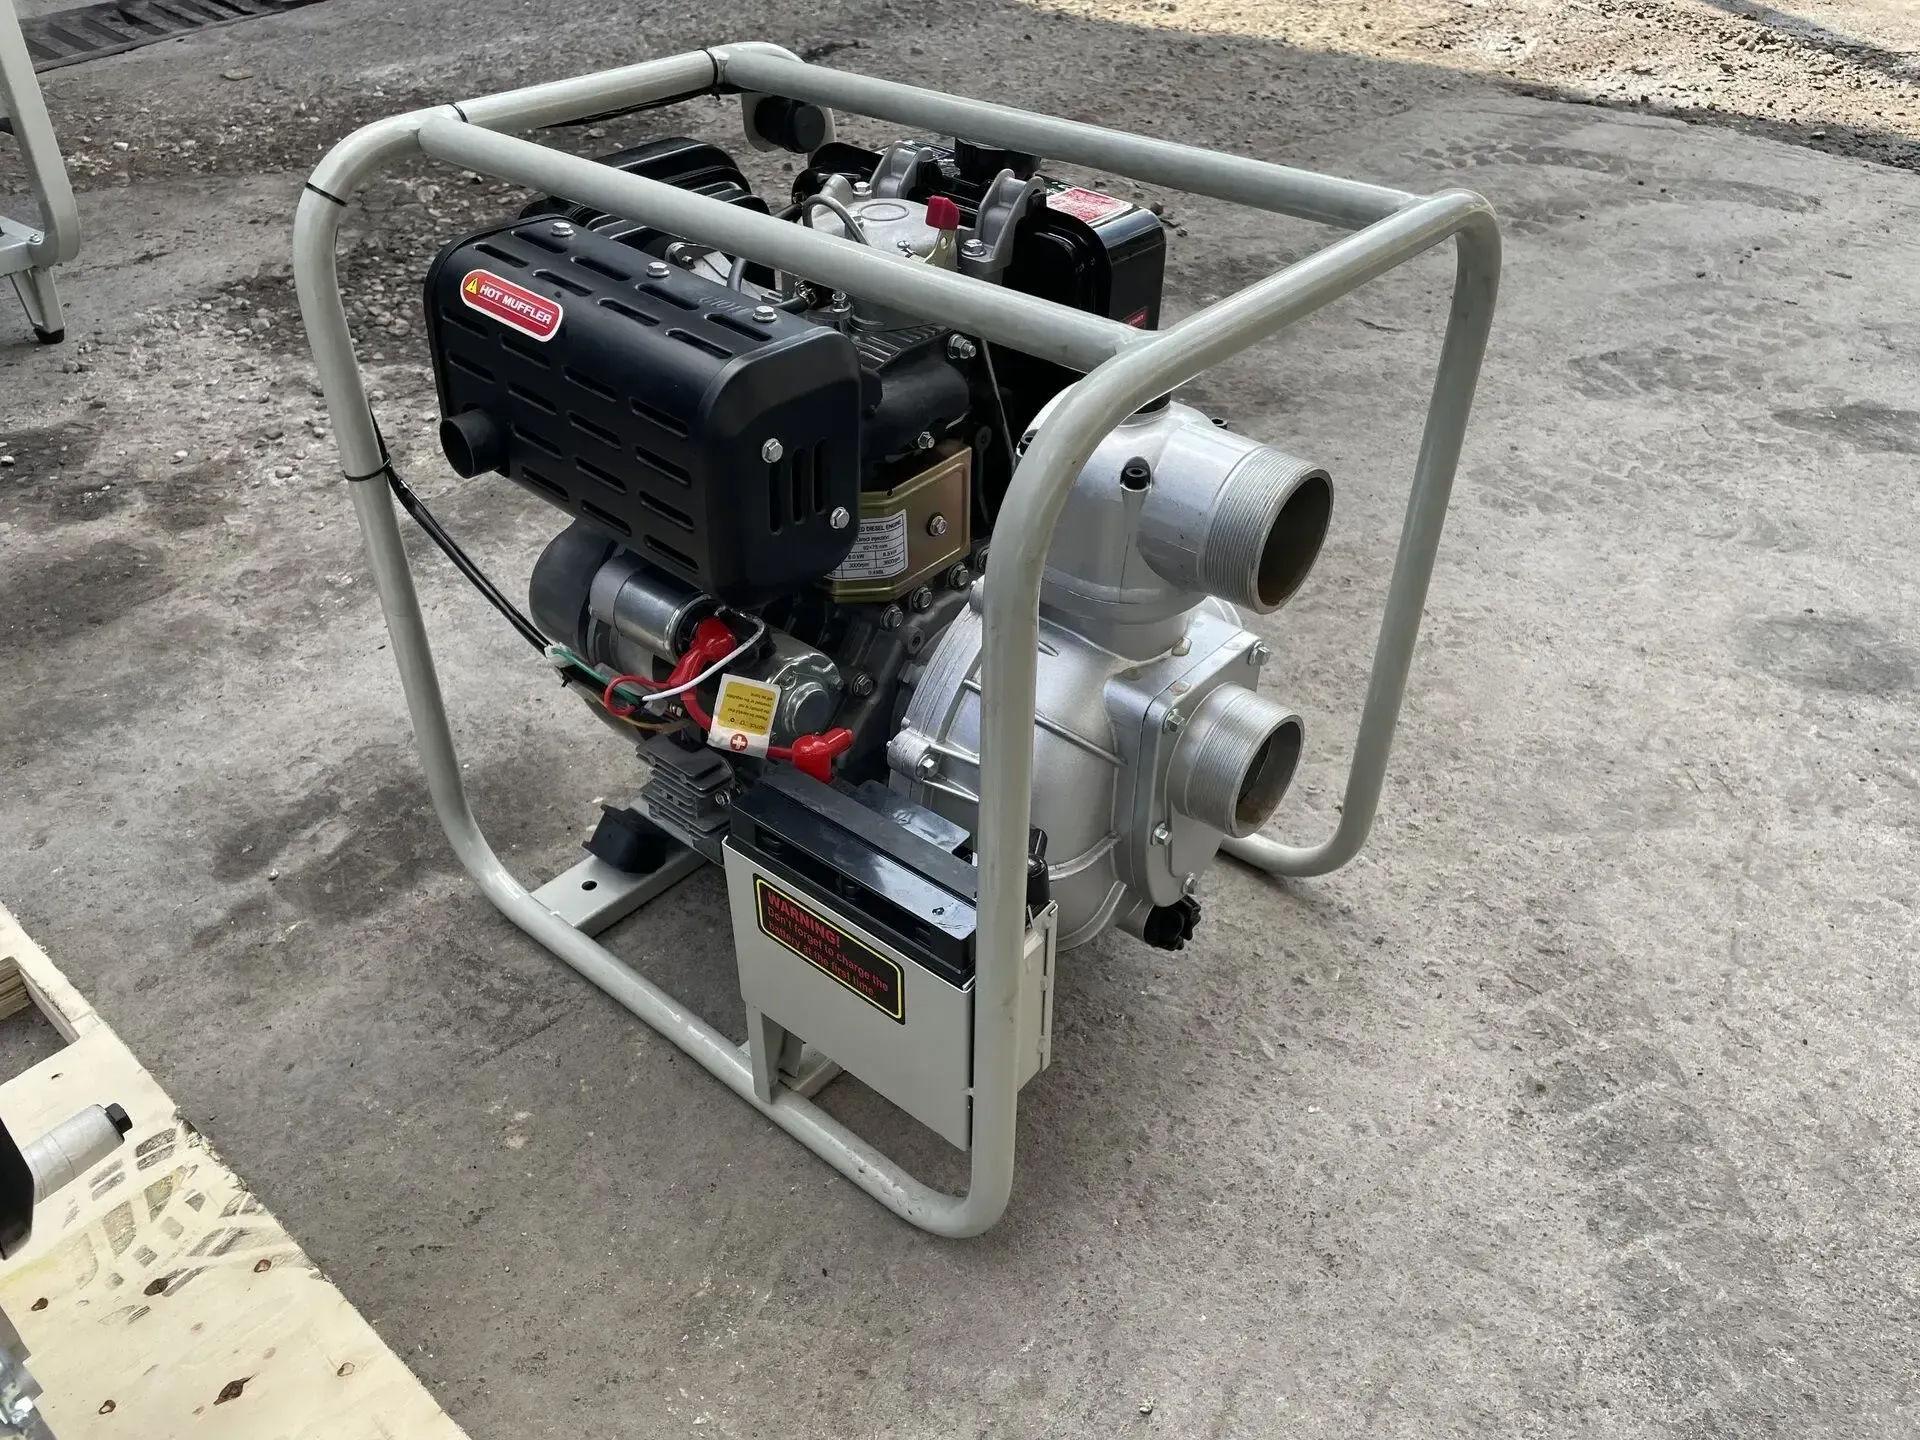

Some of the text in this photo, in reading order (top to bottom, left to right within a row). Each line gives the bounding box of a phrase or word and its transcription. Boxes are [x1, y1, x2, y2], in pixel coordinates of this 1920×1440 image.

[480, 285, 552, 324] HOT MUFFLER
[885, 519, 902, 530] ENGINE
[768, 891, 841, 948] WARNING!
[767, 906, 888, 992] Don't forget to charge the
[768, 921, 877, 998] battery at the first time.
